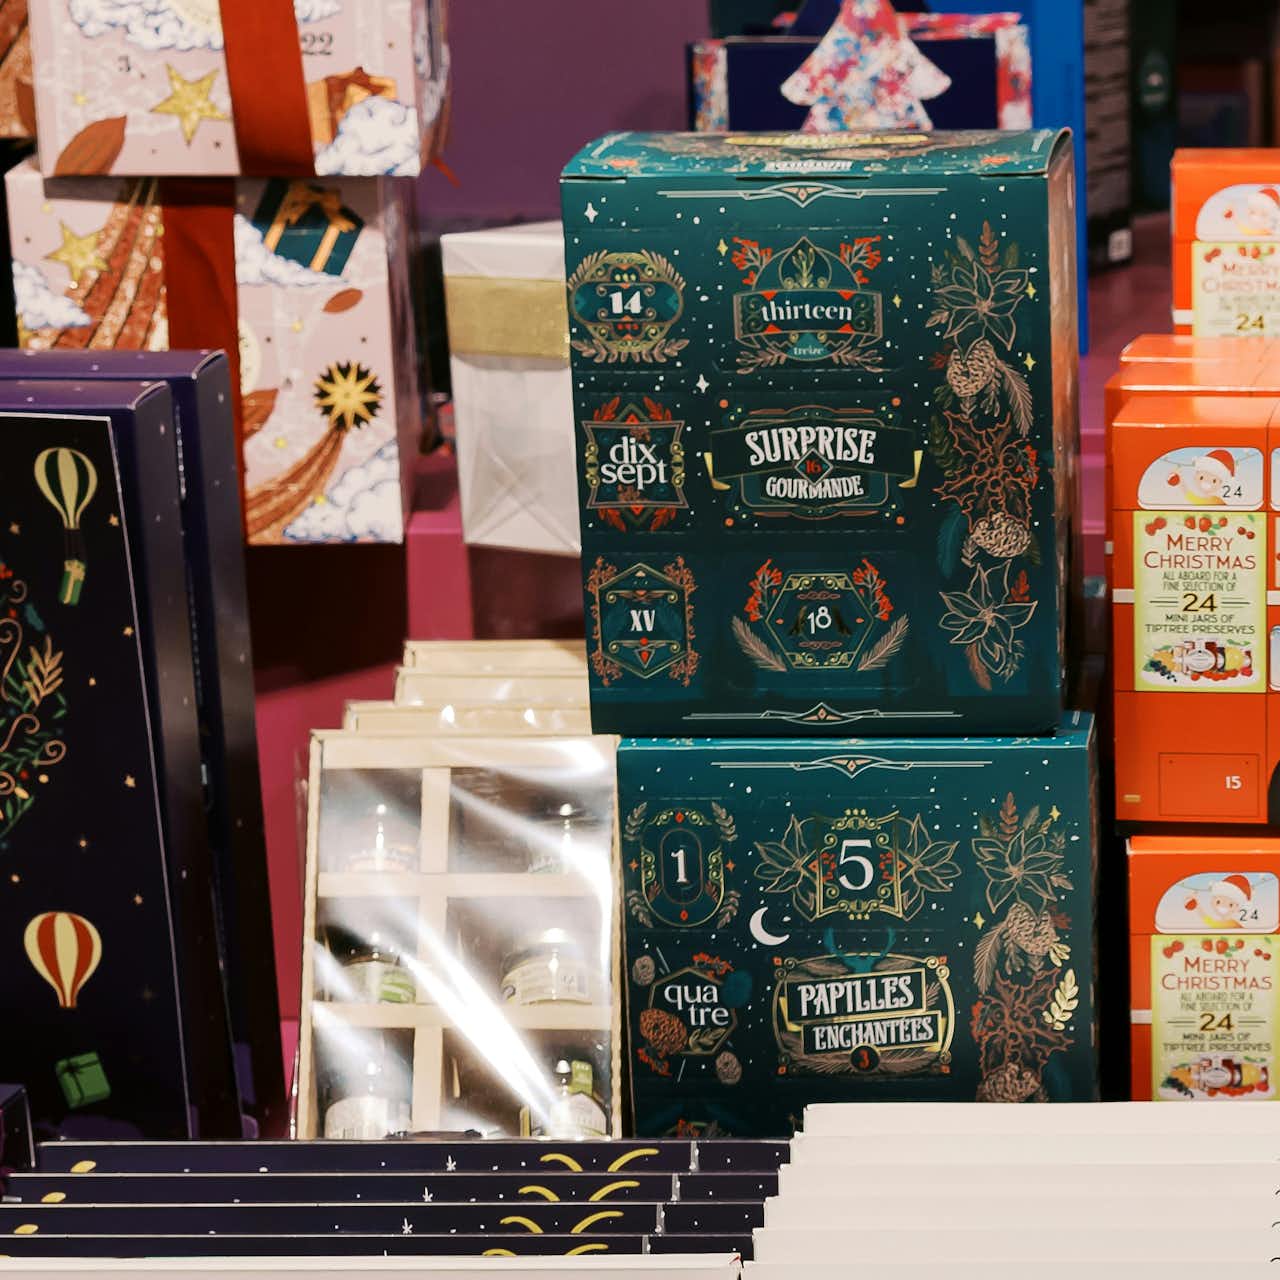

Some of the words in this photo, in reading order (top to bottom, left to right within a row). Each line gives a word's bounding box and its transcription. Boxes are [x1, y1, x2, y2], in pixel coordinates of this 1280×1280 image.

[610, 291, 642, 313] 14
[761, 300, 852, 321] thirteen
[1237, 314, 1264, 330] 24
[610, 436, 656, 469] dix
[745, 427, 876, 469] SURPRISE
[601, 457, 667, 489] sept
[766, 471, 864, 500] GOURMANDE
[1222, 485, 1242, 498] 24
[1168, 534, 1232, 551] MERRY
[1144, 551, 1256, 569] CHRISTMAS
[1163, 571, 1175, 580] ALL
[1178, 571, 1211, 580] ABOARD
[1213, 571, 1228, 580] FOR
[1231, 571, 1237, 580] A
[1163, 582, 1179, 591] FINE
[1183, 582, 1223, 592] SELECTION
[1183, 594, 1217, 612] 24
[631, 610, 655, 631] XV
[807, 606, 831, 634] 18
[1165, 614, 1188, 623] MINI
[1192, 614, 1217, 623] JARS
[1221, 614, 1234, 623] OF
[1145, 624, 1189, 634] TIPTREE
[1192, 624, 1255, 635] PRESERVES
[1225, 776, 1241, 789] 15
[671, 849, 687, 882] 1
[839, 840, 873, 890] 5
[1240, 909, 1258, 921] 24
[1184, 957, 1249, 973] MERRY
[1162, 973, 1272, 990] CHRISTMAS
[664, 985, 718, 1014] qua
[797, 975, 915, 1017] PAPILLES
[689, 1004, 728, 1025] tre
[1200, 1013, 1233, 1031] 24
[859, 1050, 869, 1067] 3
